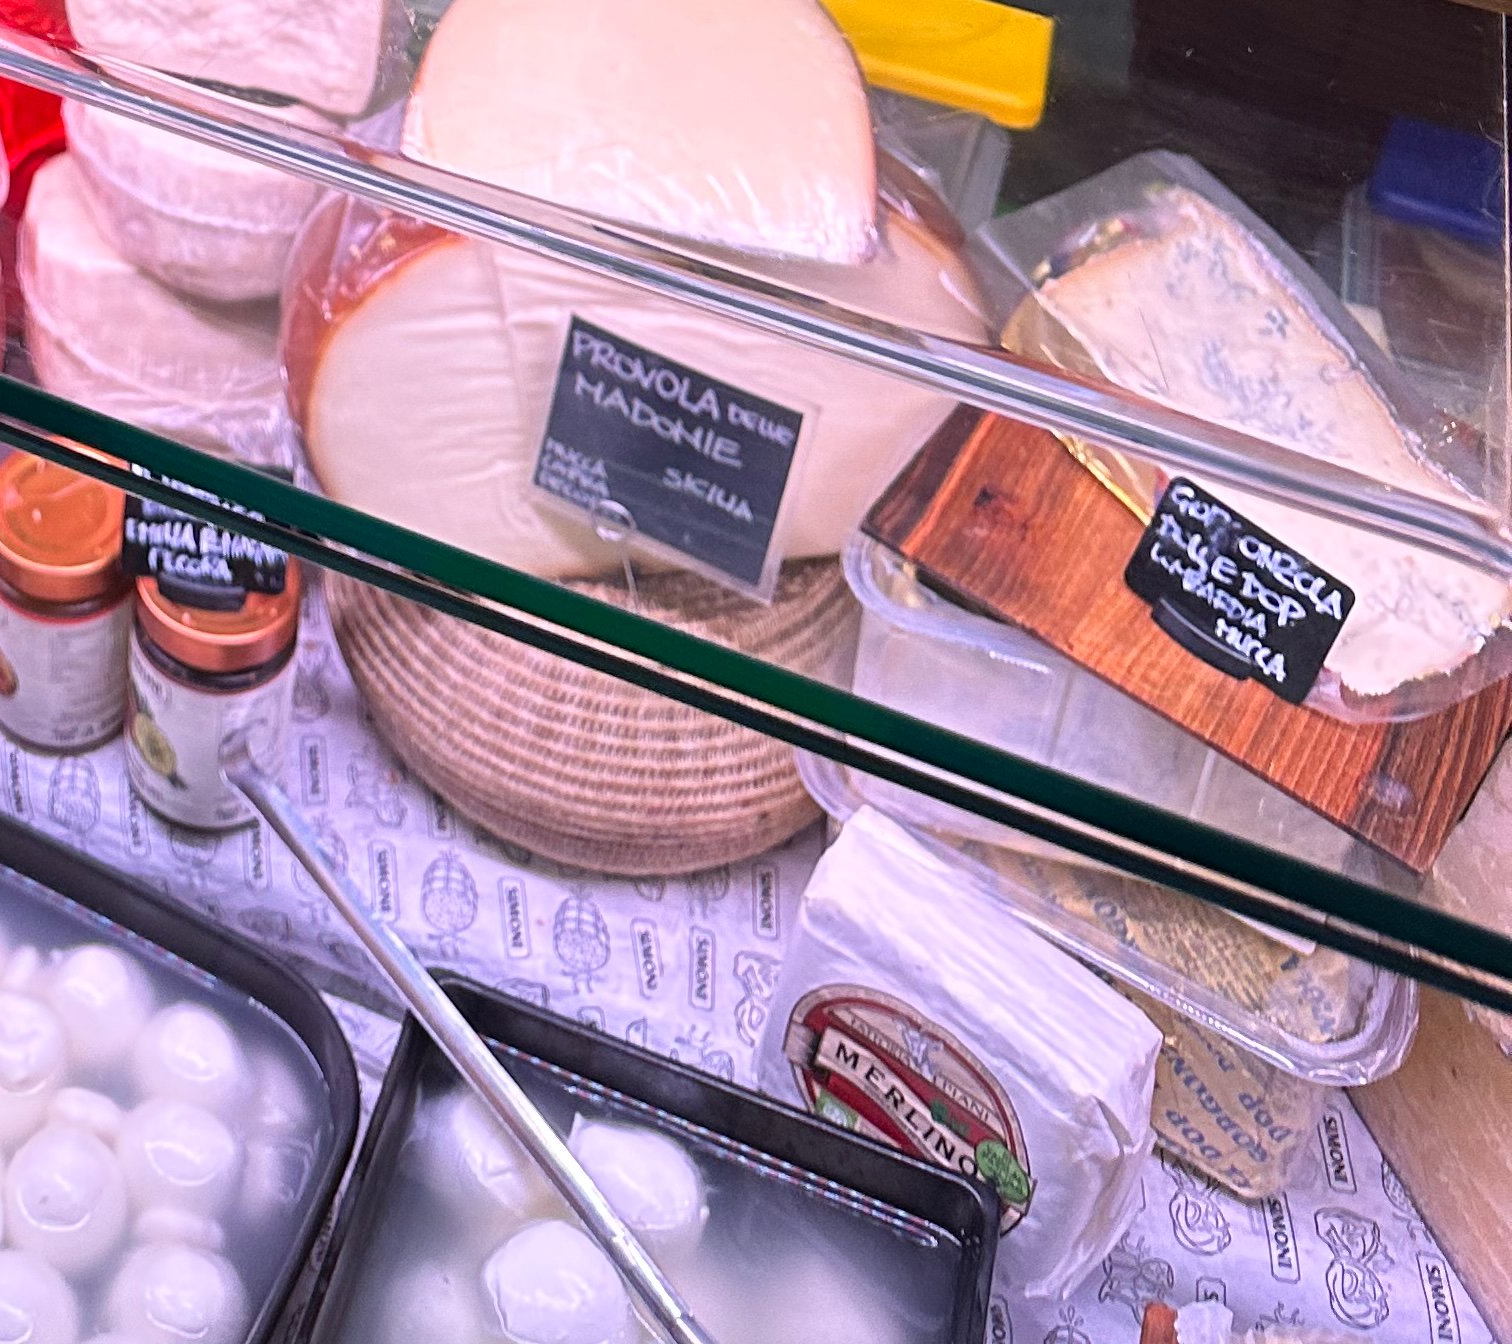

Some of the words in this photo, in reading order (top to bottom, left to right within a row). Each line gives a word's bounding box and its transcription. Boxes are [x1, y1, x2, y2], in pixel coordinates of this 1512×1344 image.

[571, 328, 721, 422] PROVOLA
[1215, 617, 1287, 683] MUCCA
[834, 1040, 980, 1178] MERLINO
[1322, 1114, 1348, 1184] SIMONI
[1267, 1197, 1293, 1270] SIMONI
[1425, 1263, 1454, 1341] SIMONI
